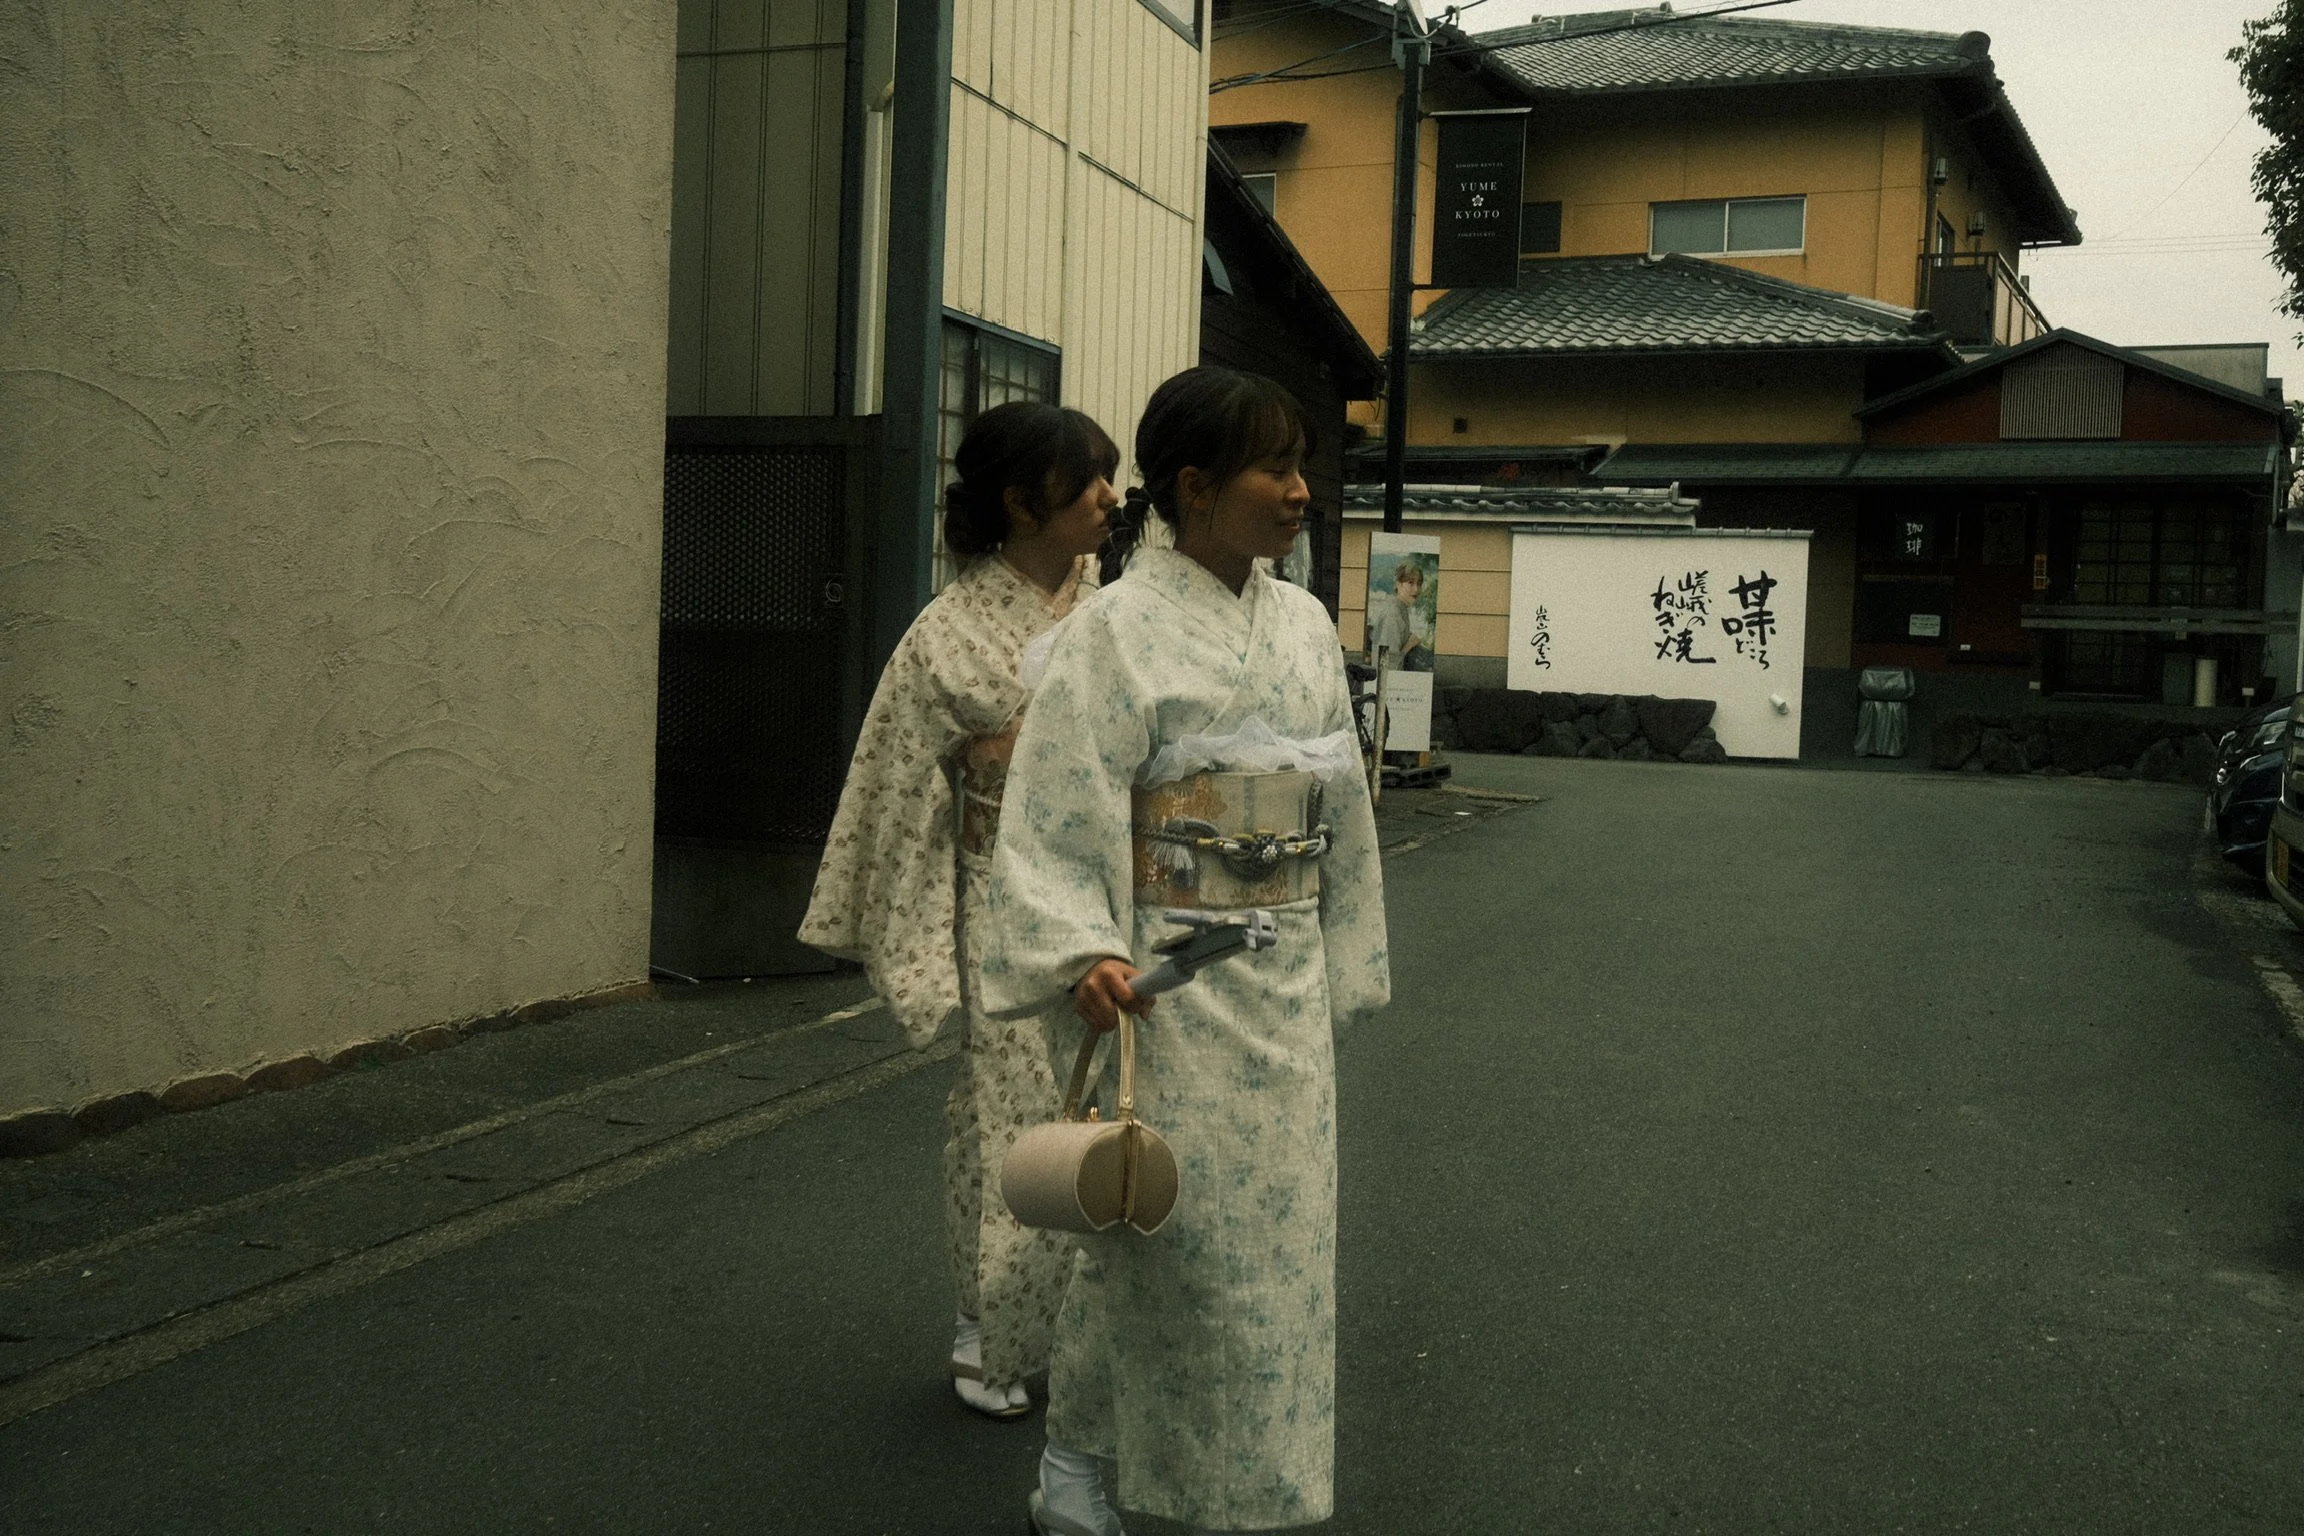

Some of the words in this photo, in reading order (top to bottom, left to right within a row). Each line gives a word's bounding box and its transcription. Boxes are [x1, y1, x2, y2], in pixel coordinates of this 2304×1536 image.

[1460, 181, 1497, 192] YUME
[1455, 210, 1500, 220] KYOTO
[1905, 522, 1924, 556] 珈琲
[1721, 570, 1778, 670] 甘味どころ
